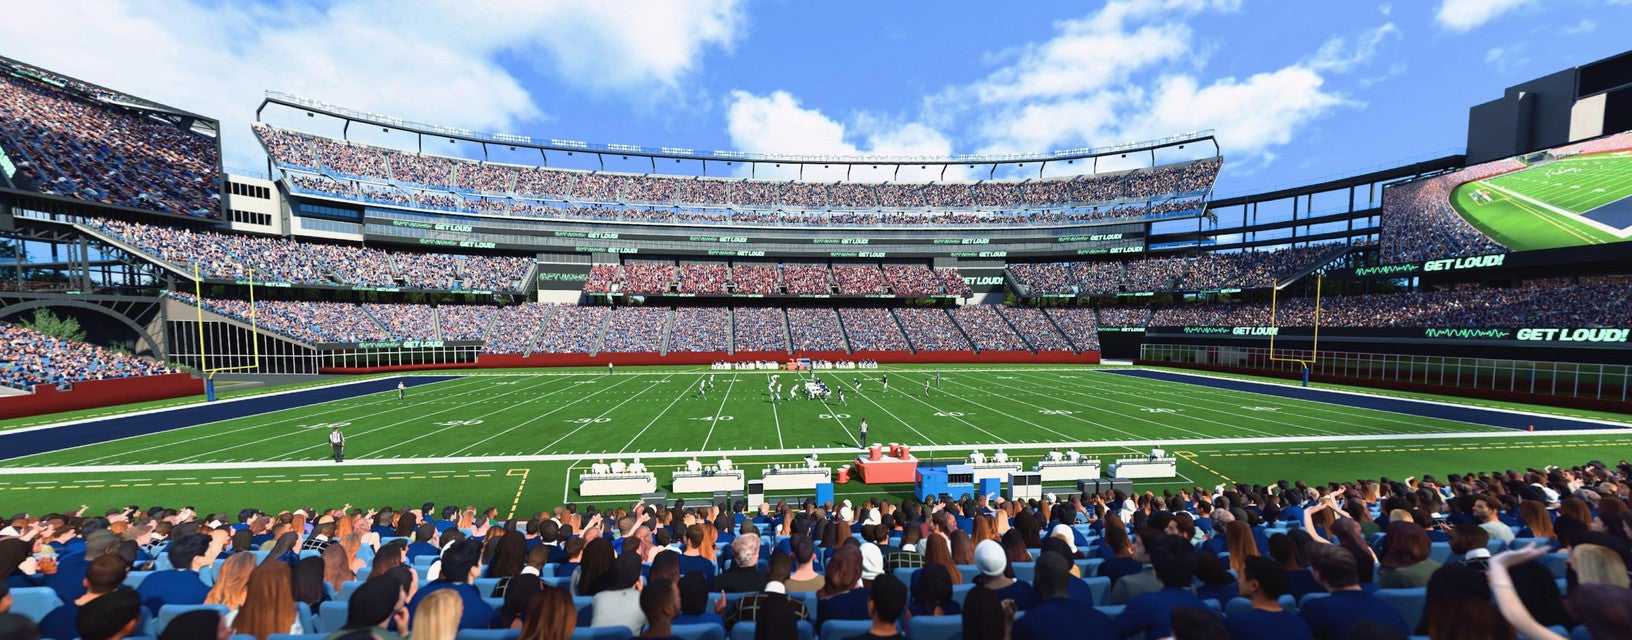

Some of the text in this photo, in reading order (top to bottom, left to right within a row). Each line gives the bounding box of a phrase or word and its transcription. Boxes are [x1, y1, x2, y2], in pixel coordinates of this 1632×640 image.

[1424, 254, 1505, 271] GET LOUD!
[1517, 329, 1628, 342] GET LOUD!
